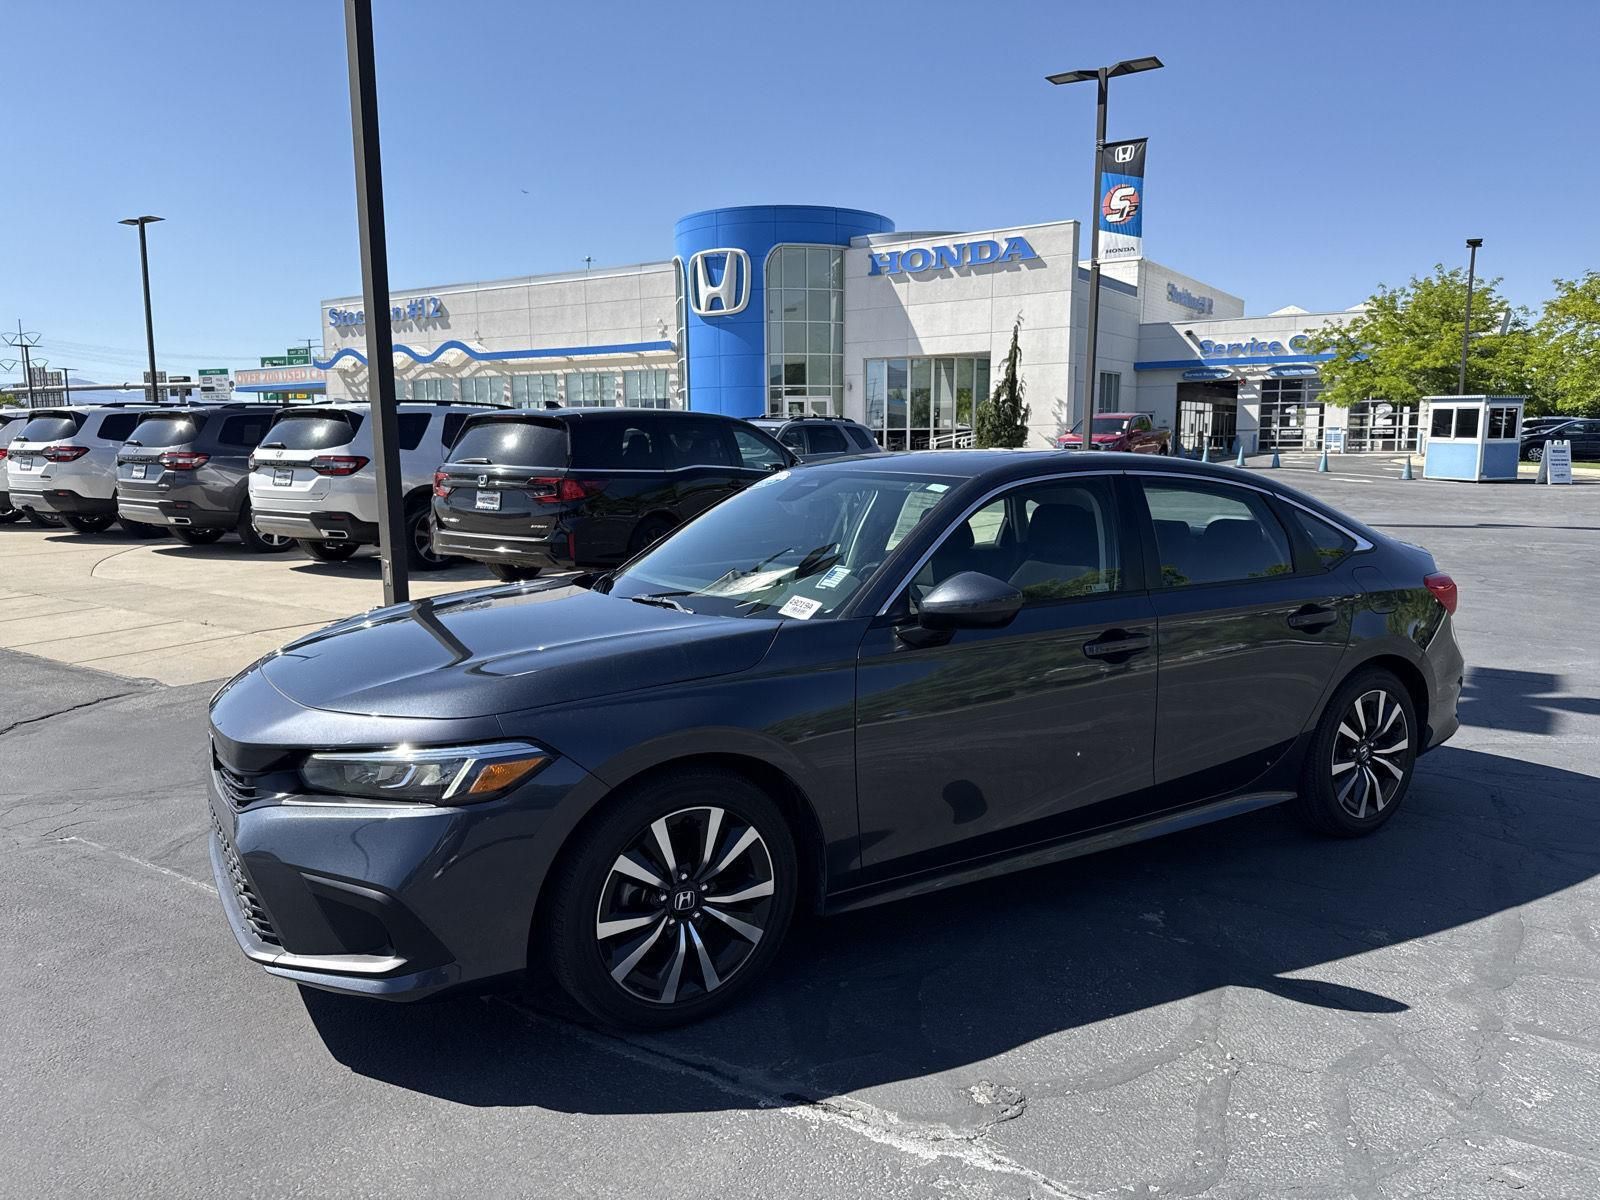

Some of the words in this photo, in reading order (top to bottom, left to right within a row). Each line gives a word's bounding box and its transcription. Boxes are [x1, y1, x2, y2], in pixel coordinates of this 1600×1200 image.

[868, 236, 1039, 276] HONDA
[1105, 246, 1136, 254] HONDA
[329, 304, 402, 327] Stocn
[407, 297, 442, 320] #12
[1200, 337, 1282, 356] Service
[282, 369, 306, 382] USED
[1285, 404, 1298, 427] 1
[1375, 403, 1393, 426] 2
